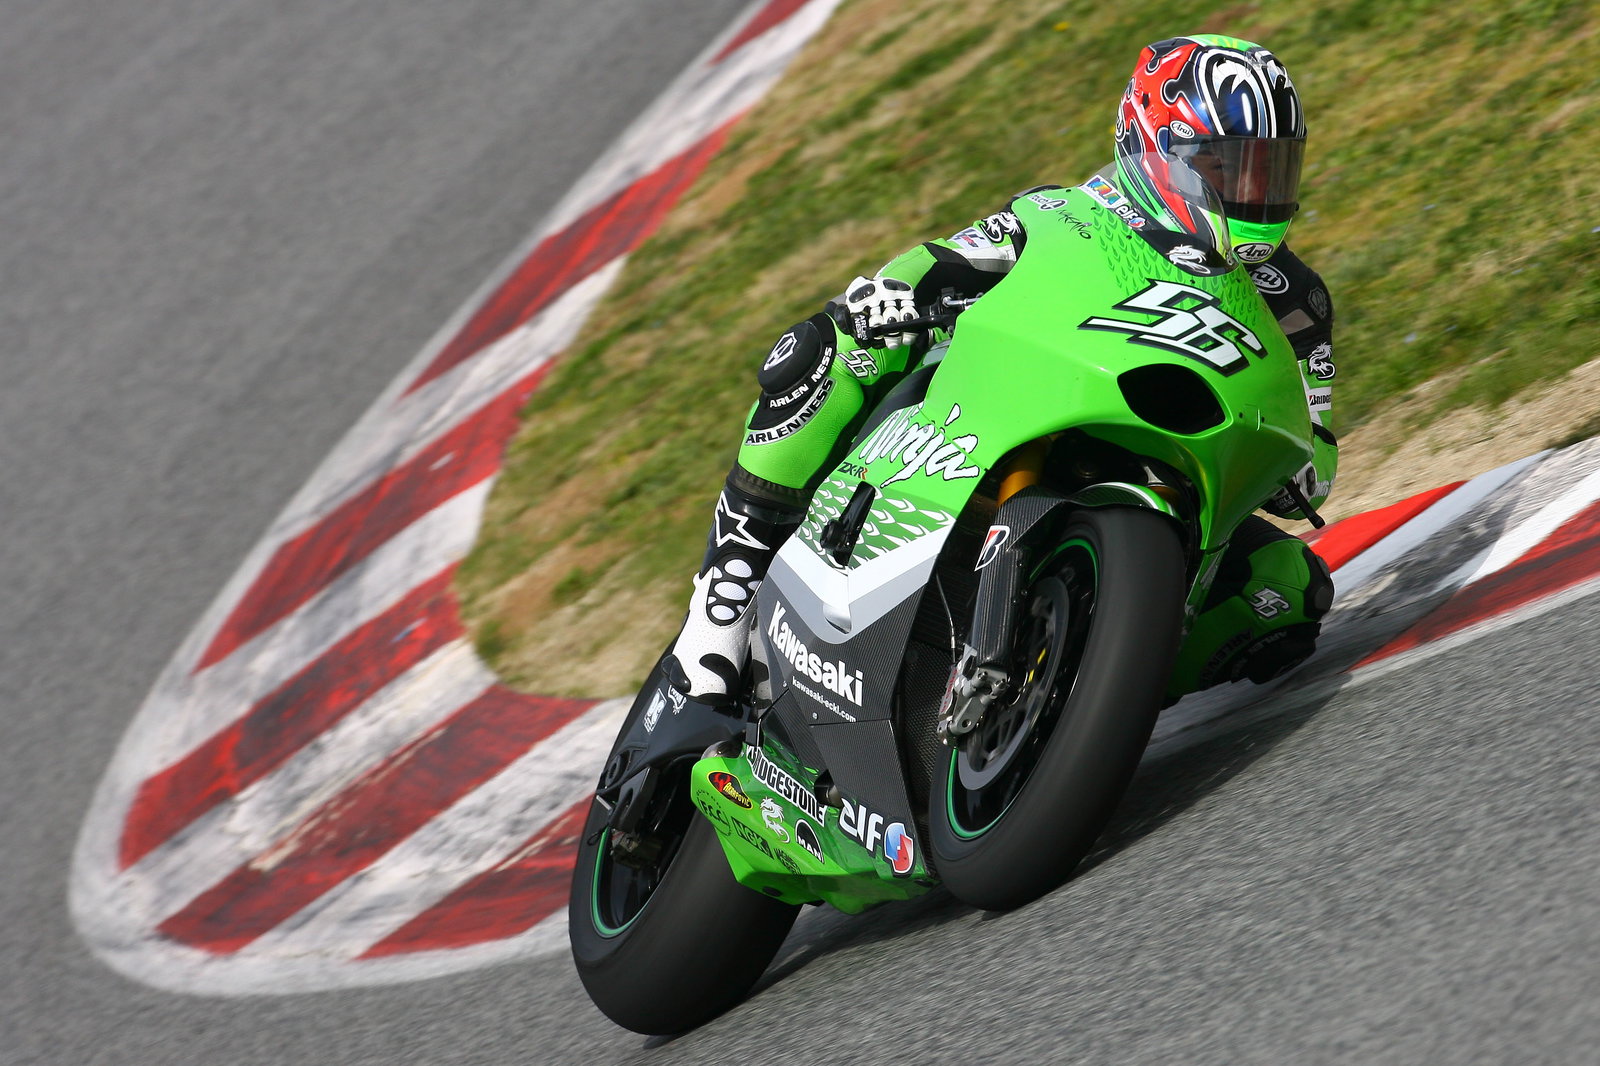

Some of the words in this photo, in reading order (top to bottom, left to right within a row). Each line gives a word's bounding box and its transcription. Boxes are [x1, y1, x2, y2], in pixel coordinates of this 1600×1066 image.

[1116, 205, 1139, 222] elf
[1238, 245, 1272, 257] Arai
[1250, 271, 1280, 286] rai
[1078, 278, 1268, 377] 56
[769, 384, 809, 408] ARLEN
[810, 346, 833, 383] NESS
[837, 349, 878, 378] 56
[745, 419, 800, 444] ARLEN
[798, 378, 834, 422] NESS
[858, 402, 980, 489] Ninja
[1250, 587, 1290, 619] 56
[768, 600, 864, 707] Kawasaki
[838, 798, 884, 852] elf
